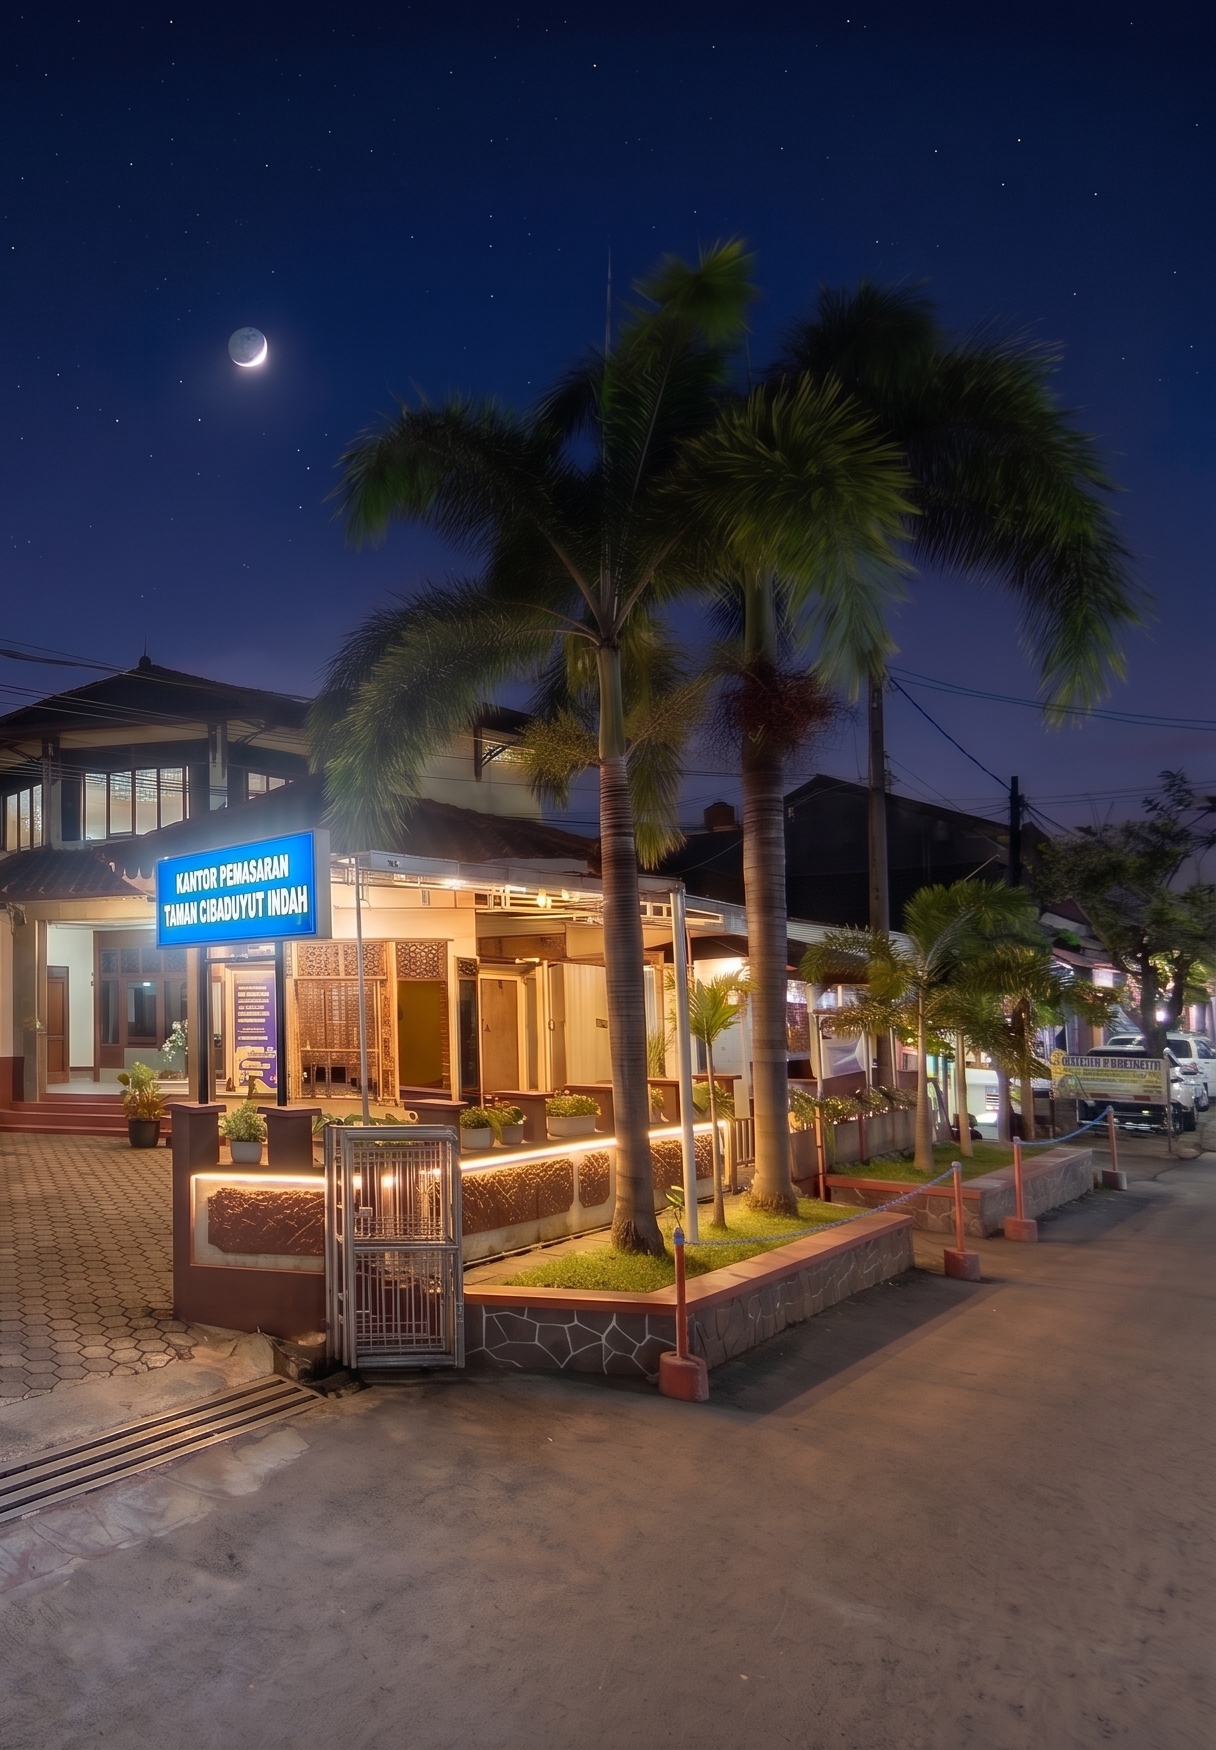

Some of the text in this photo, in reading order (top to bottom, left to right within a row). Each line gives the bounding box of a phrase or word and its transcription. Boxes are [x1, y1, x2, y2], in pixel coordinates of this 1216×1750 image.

[176, 854, 289, 894] KANTOR PEMASARAN
[164, 885, 308, 927] TAMAN CIBADUYUT INDAH
